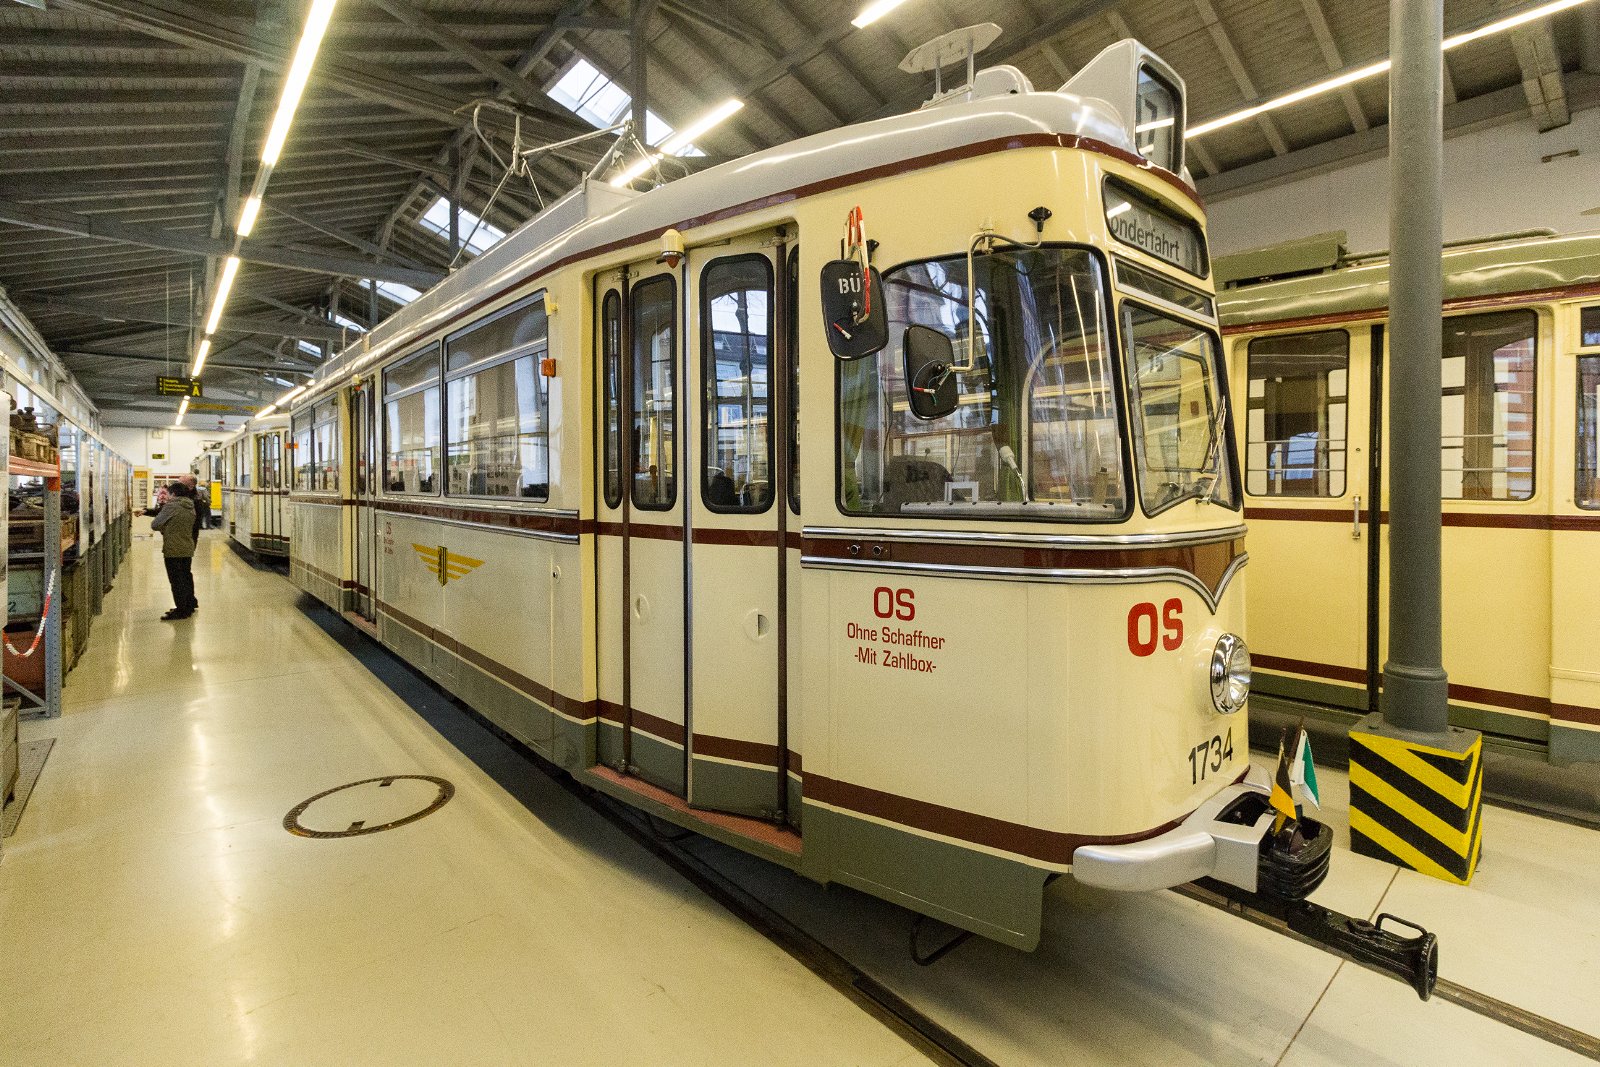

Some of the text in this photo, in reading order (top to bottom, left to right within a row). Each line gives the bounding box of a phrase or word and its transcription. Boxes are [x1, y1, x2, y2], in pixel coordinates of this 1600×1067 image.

[1110, 217, 1180, 261] onderfahrt
[838, 272, 871, 294] BÜ
[874, 586, 915, 621] OS
[847, 622, 946, 649] Ohne Schaffner
[1127, 598, 1184, 657] OS
[855, 646, 937, 673] -Mit Zahlbox-
[1188, 727, 1233, 785] 1734
